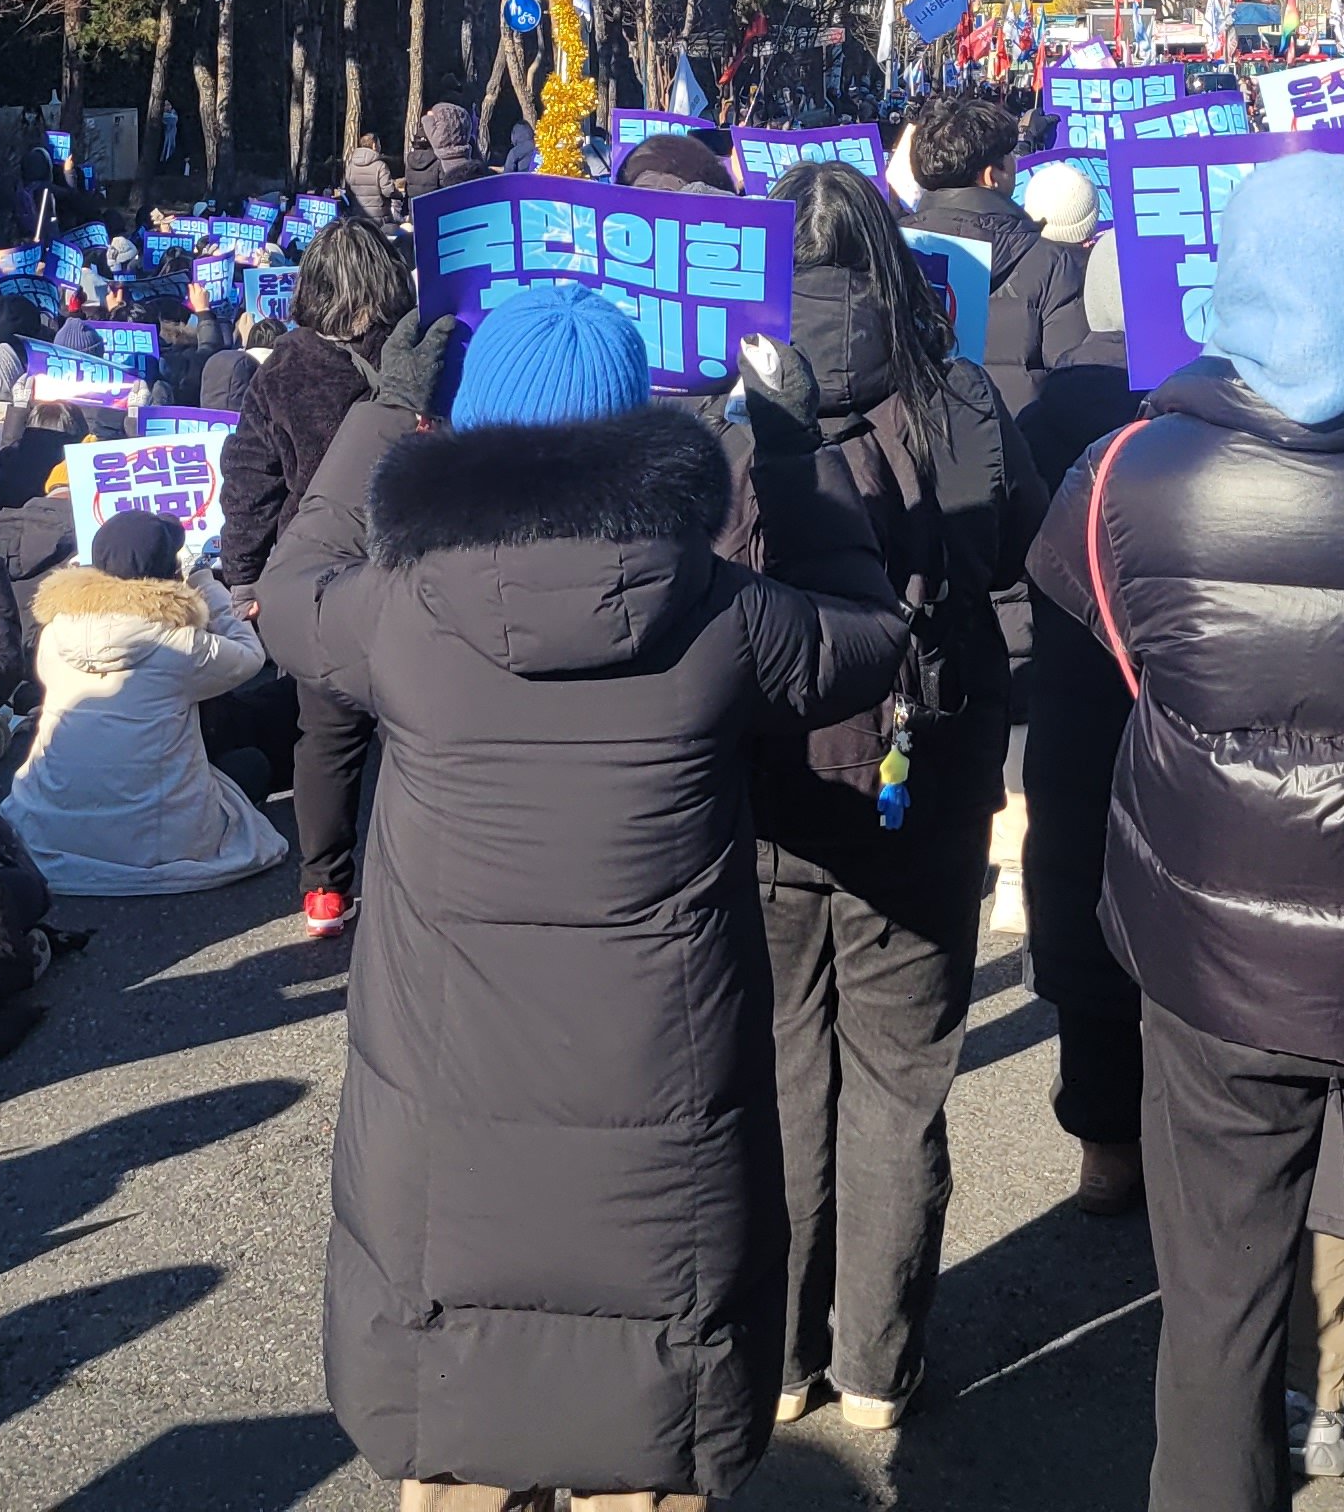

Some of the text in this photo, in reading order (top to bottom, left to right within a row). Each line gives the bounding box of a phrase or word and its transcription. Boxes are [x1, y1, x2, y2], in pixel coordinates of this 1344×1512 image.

[1050, 74, 1176, 111] 국민의힘
[740, 137, 878, 178] 국민의힘
[212, 221, 265, 242] 국민의힘
[438, 200, 766, 301] 국민의힘
[258, 273, 297, 296] 윤석
[94, 445, 210, 494] 윤석열
